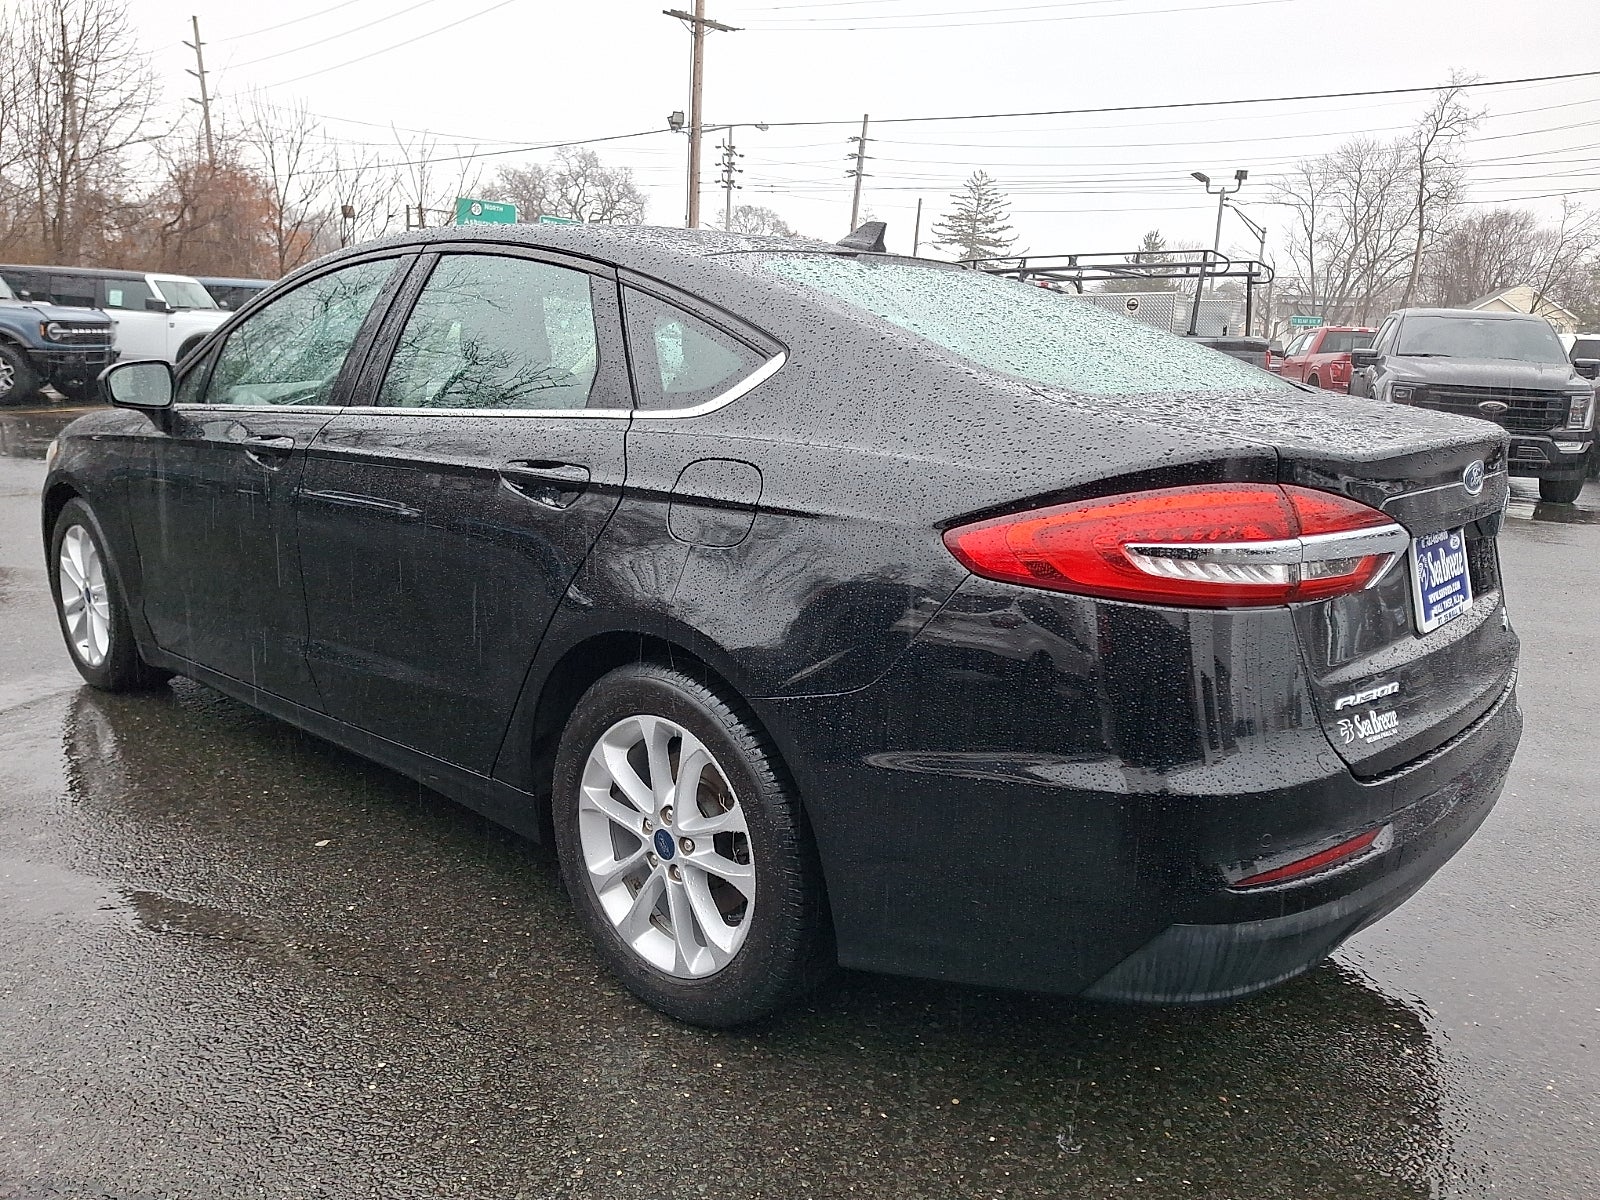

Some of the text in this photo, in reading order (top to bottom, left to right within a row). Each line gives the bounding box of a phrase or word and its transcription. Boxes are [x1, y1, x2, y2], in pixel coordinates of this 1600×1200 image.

[1427, 547, 1464, 588] Sea Breeze
[1354, 715, 1375, 739] Sea
[1369, 710, 1399, 734] Breeze
